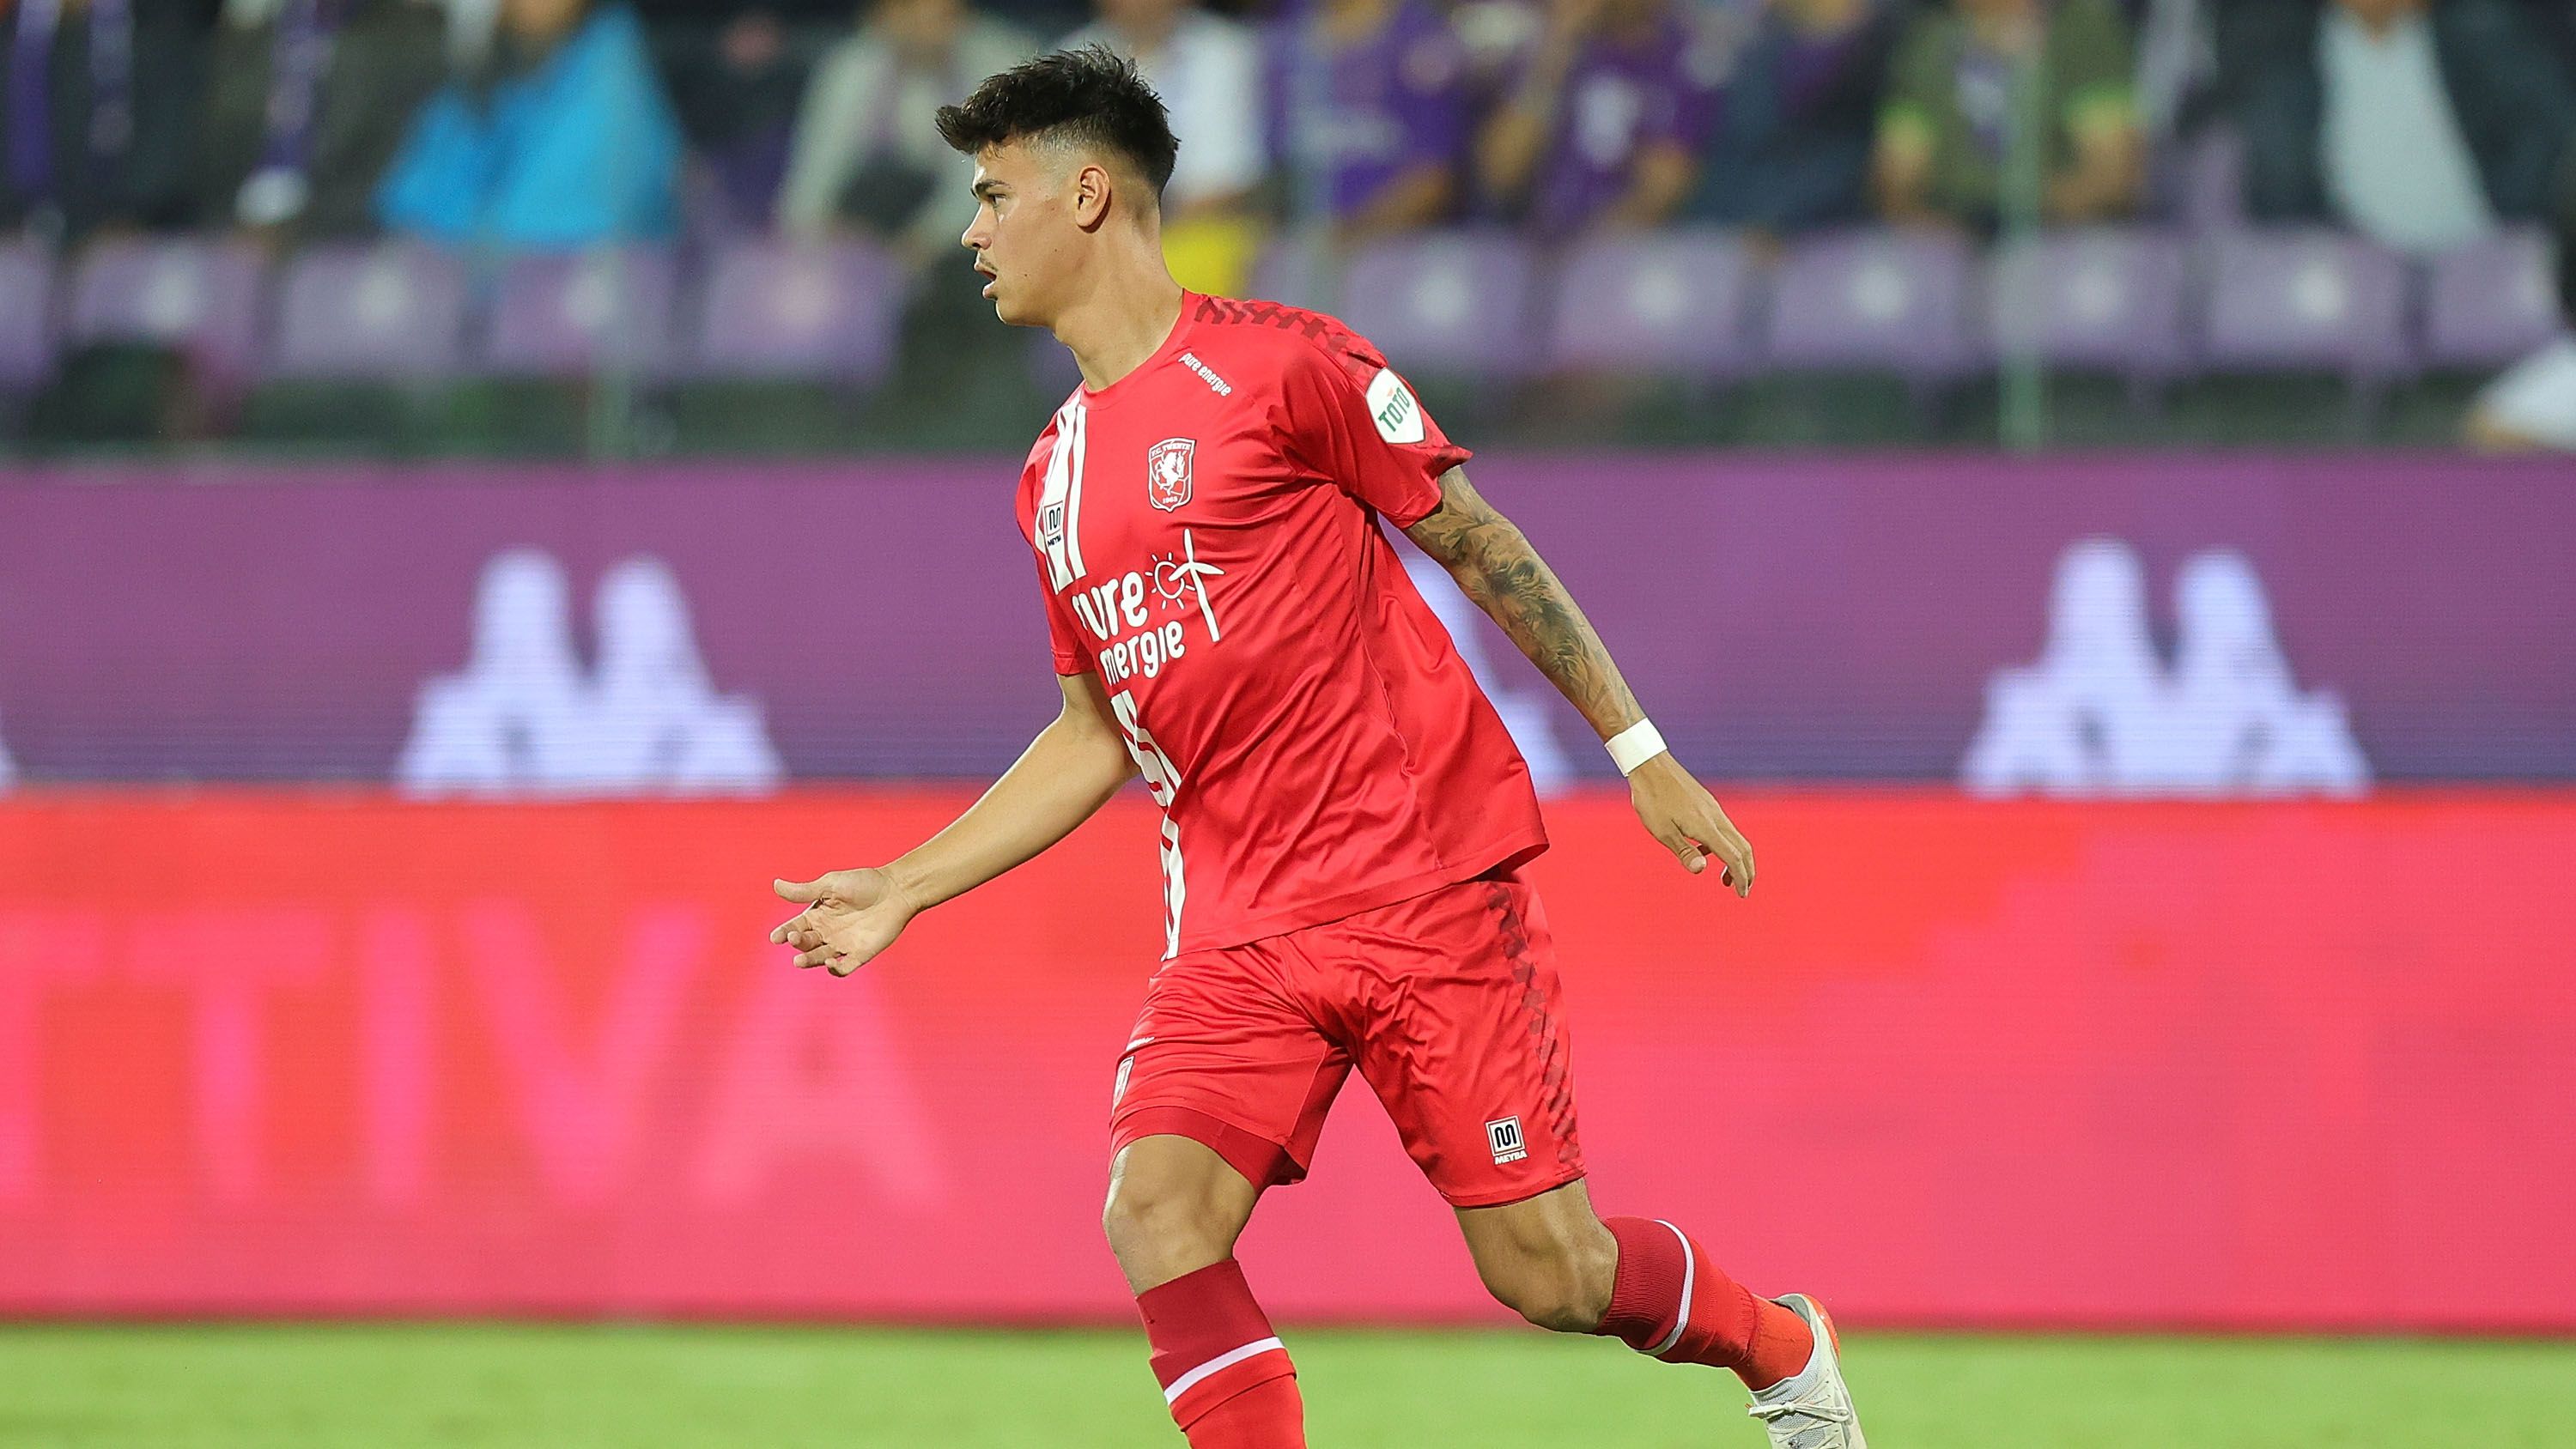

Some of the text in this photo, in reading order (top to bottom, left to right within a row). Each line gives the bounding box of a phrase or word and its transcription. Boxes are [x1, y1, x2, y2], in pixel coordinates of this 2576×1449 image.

[1177, 352, 1232, 397] pure energie
[1378, 387, 1410, 433] TOTO
[1494, 1149, 1528, 1165] MEYBA
